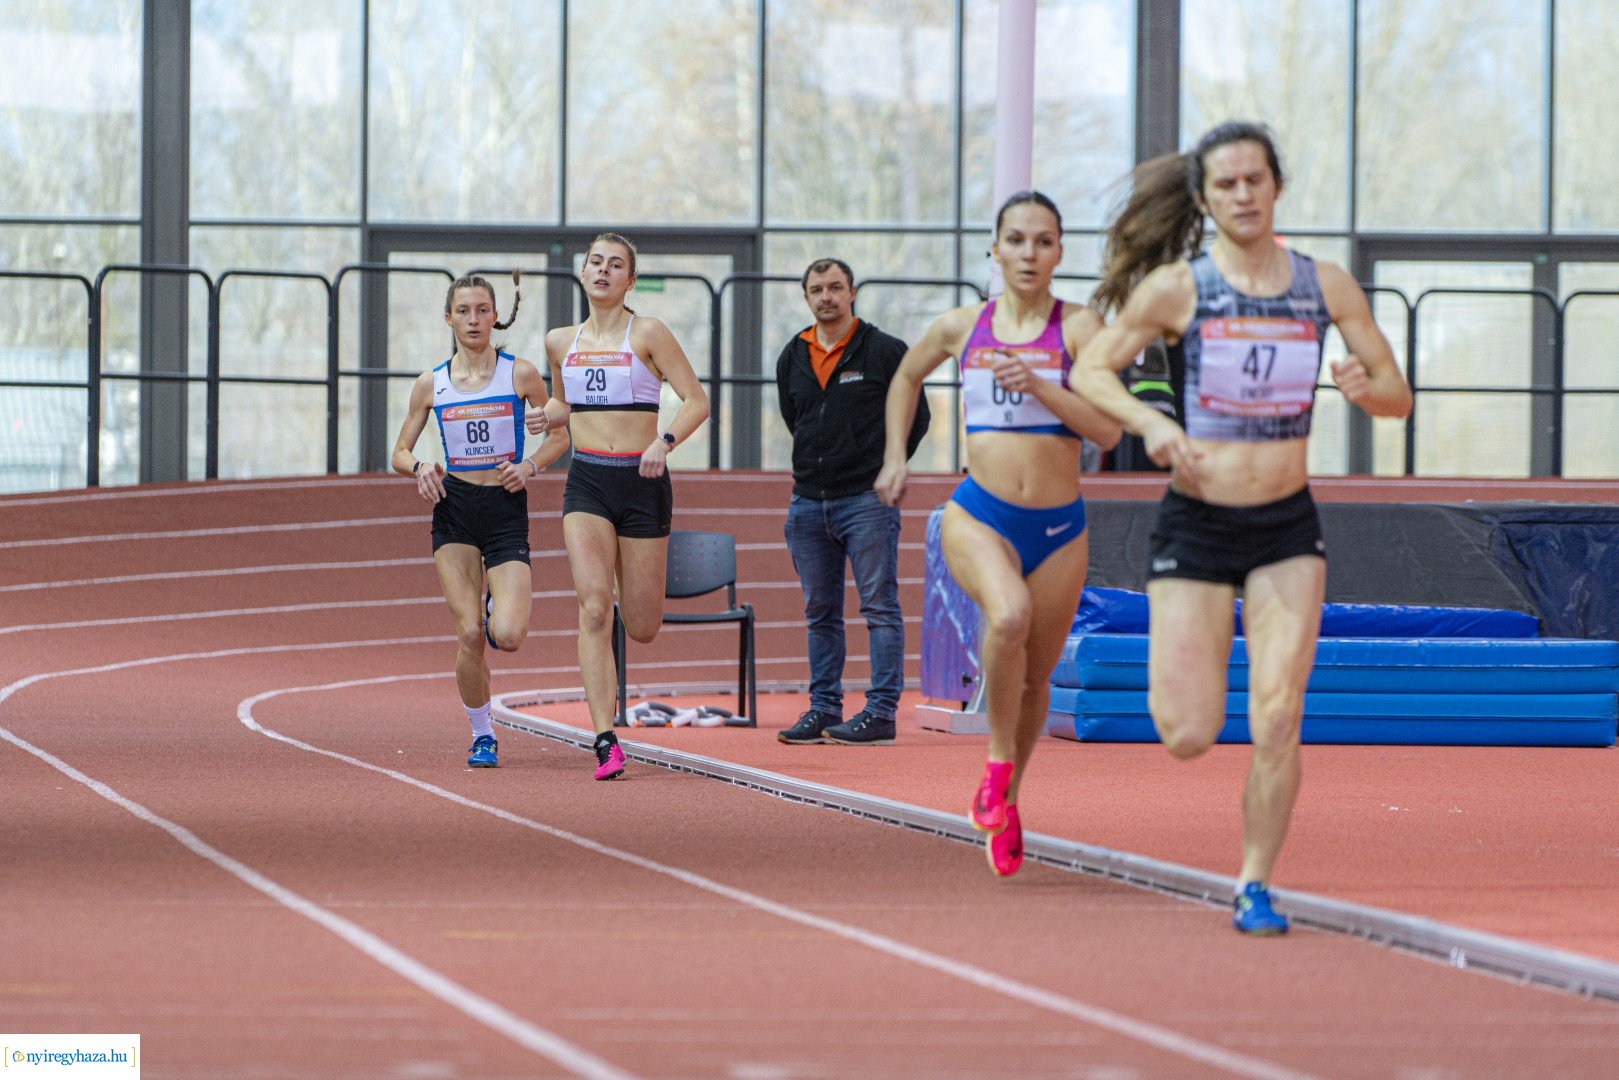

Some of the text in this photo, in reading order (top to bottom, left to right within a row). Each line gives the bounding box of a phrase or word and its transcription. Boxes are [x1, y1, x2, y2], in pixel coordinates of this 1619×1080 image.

[1243, 344, 1277, 381] 47
[585, 368, 607, 392] 29
[586, 395, 608, 404] BALOGH
[466, 420, 490, 444] 68
[464, 445, 495, 456] KLINCSEK
